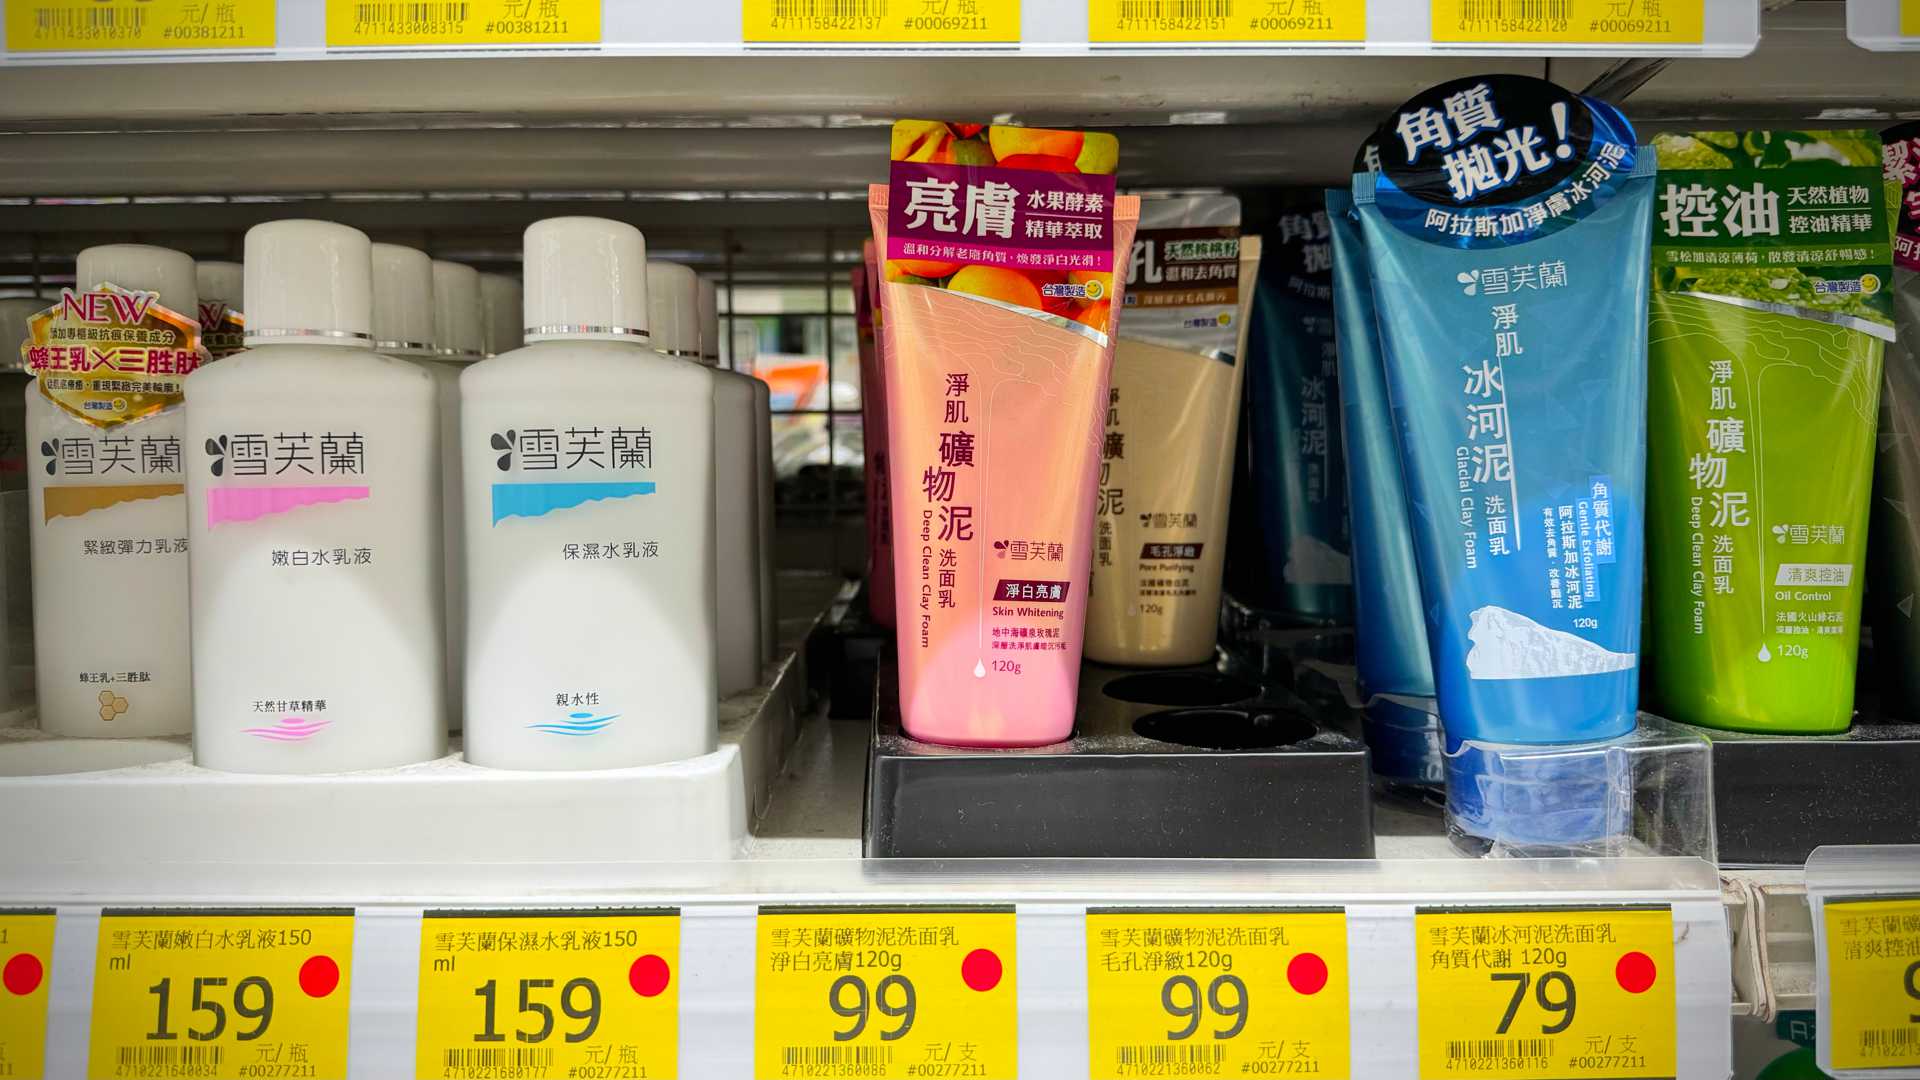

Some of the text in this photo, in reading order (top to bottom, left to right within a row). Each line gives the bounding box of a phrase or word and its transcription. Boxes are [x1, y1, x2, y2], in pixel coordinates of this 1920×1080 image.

[163, 26, 245, 39] #00381211
[354, 21, 464, 35] 4711433008315
[485, 21, 569, 34] #00381211
[771, 17, 881, 30] 4711158422137
[903, 18, 988, 30] #00069211
[1117, 18, 1227, 31] 4711158422151
[1250, 18, 1333, 30] #00069211
[1589, 20, 1672, 33] #00069211
[1396, 83, 1501, 163] 角質
[1027, 189, 1103, 213] 水果酵素
[1786, 186, 1870, 206] 天然植物
[904, 177, 1020, 239] 亮膚
[1659, 182, 1780, 237] 控油
[1025, 219, 1103, 240] 精華萃取
[1789, 214, 1872, 235] 控油精華
[1481, 260, 1568, 295] 雪芙蘭
[63, 293, 157, 323] NEW
[62, 435, 182, 475] 雪芙蘭
[231, 432, 365, 475] 雪芙蘭
[520, 427, 652, 470] 雪芙蘭
[1456, 446, 1477, 569] Glacial Clay Foam
[1592, 482, 1613, 556] 角質代謝
[1791, 524, 1845, 544] 雪芙蘭
[272, 548, 372, 566] 嫩白水乳液
[563, 541, 659, 560] 保濕水乳液
[1010, 540, 1064, 562] 雪芙蘭
[1558, 505, 1583, 609] 阿拉斯加冰河泥
[1578, 501, 1595, 598] Gentle Exfoliating
[1689, 496, 1705, 634] Deep Clean Clay Foam
[920, 510, 933, 648] Deep Clean Clay Foam
[1788, 568, 1845, 585] 清爽控油
[1006, 584, 1062, 600] 淨白亮膚
[1775, 591, 1832, 601] Oil Control
[992, 606, 1064, 620] Skin Whitening
[1140, 604, 1164, 615] 120g
[1573, 618, 1598, 629] 120g
[1778, 644, 1809, 659] 120g
[992, 660, 1021, 674] 120g
[253, 700, 327, 713] 天然甘草精華
[556, 692, 600, 706] 親水性
[111, 928, 312, 950] 雪芙蘭嫩白水乳液150
[771, 926, 960, 948] 雪芙蘭礦物泥洗面乳
[1099, 926, 1290, 948] 雪芙蘭礦物泥洗面乳
[1429, 923, 1617, 946] 雪芙蘭冰河泥洗面乳
[109, 954, 131, 970] ml
[434, 956, 455, 972] ml
[770, 950, 902, 972] 淨白亮膚120g
[1101, 950, 1233, 972] 毛孔淨緻120g
[1431, 948, 1567, 970] 角質代謝 120g
[146, 976, 274, 1041] 159
[473, 977, 602, 1043] 159
[829, 974, 917, 1041] 99
[1161, 974, 1249, 1041] 99
[1490, 971, 1577, 1035] 79
[239, 1064, 316, 1077] #00277211
[443, 1066, 548, 1079] 4710221680177
[568, 1066, 648, 1079] #00277211
[782, 1064, 887, 1077] 4710221360086
[907, 1064, 987, 1077] #00277211
[1117, 1063, 1221, 1076] 4710221360062
[1241, 1061, 1320, 1074] #00277211
[1446, 1057, 1549, 1070] 4710221360116
[1568, 1056, 1647, 1069] #00277211
